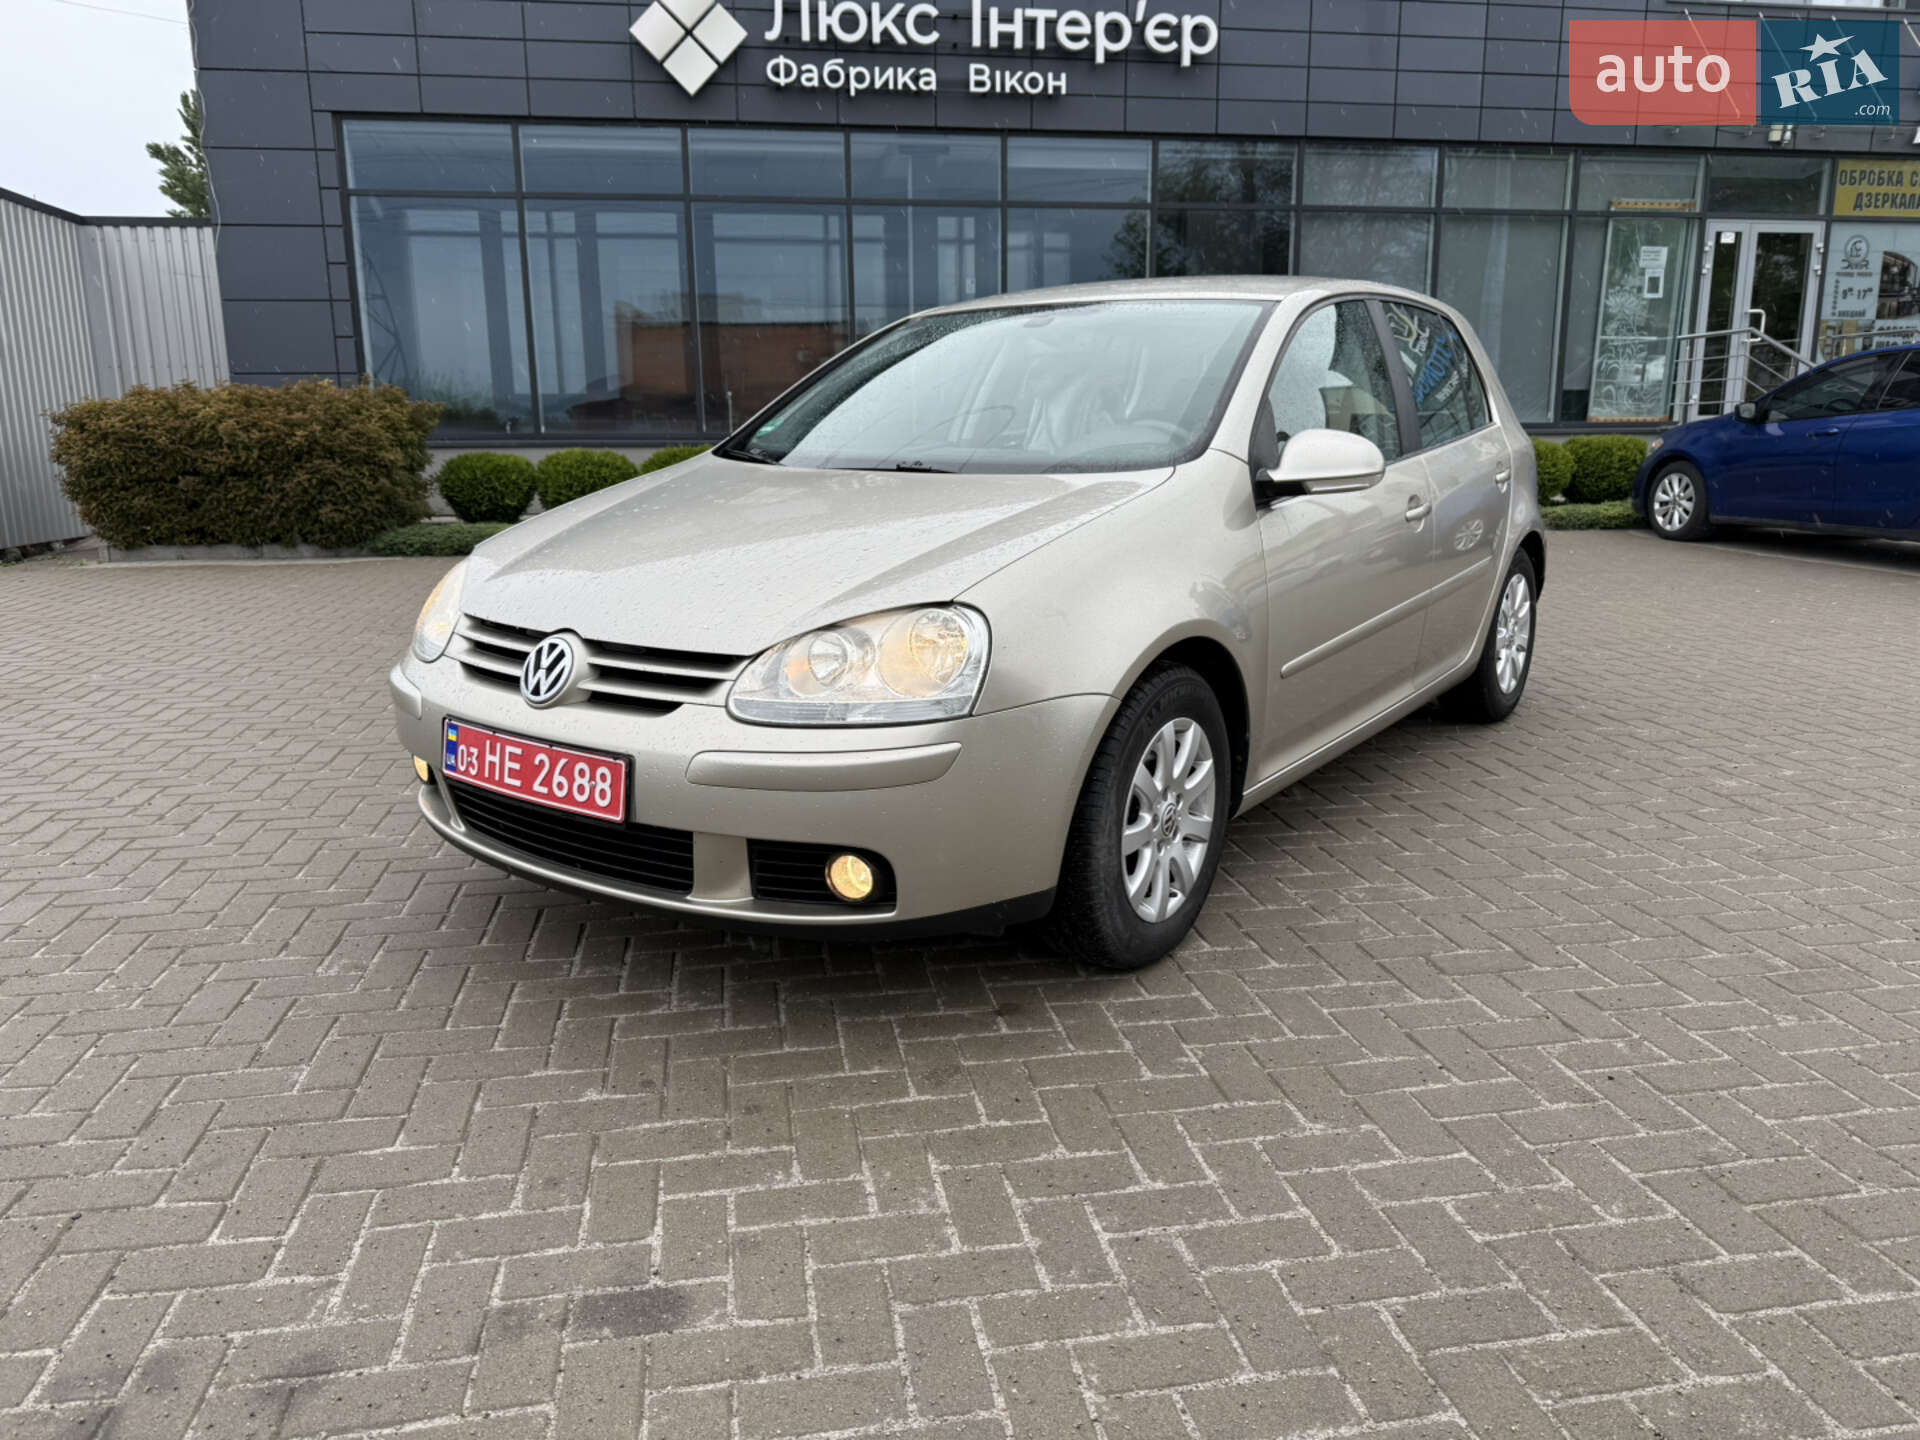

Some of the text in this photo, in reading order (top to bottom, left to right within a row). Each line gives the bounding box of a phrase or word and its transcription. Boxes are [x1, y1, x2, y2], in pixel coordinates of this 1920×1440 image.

[764, 0, 940, 45] Люкс
[766, 54, 1067, 97] Фабрика Вікон
[1839, 169, 1920, 188] ОБРОБКА С
[458, 740, 612, 808] 03 HE 2688
